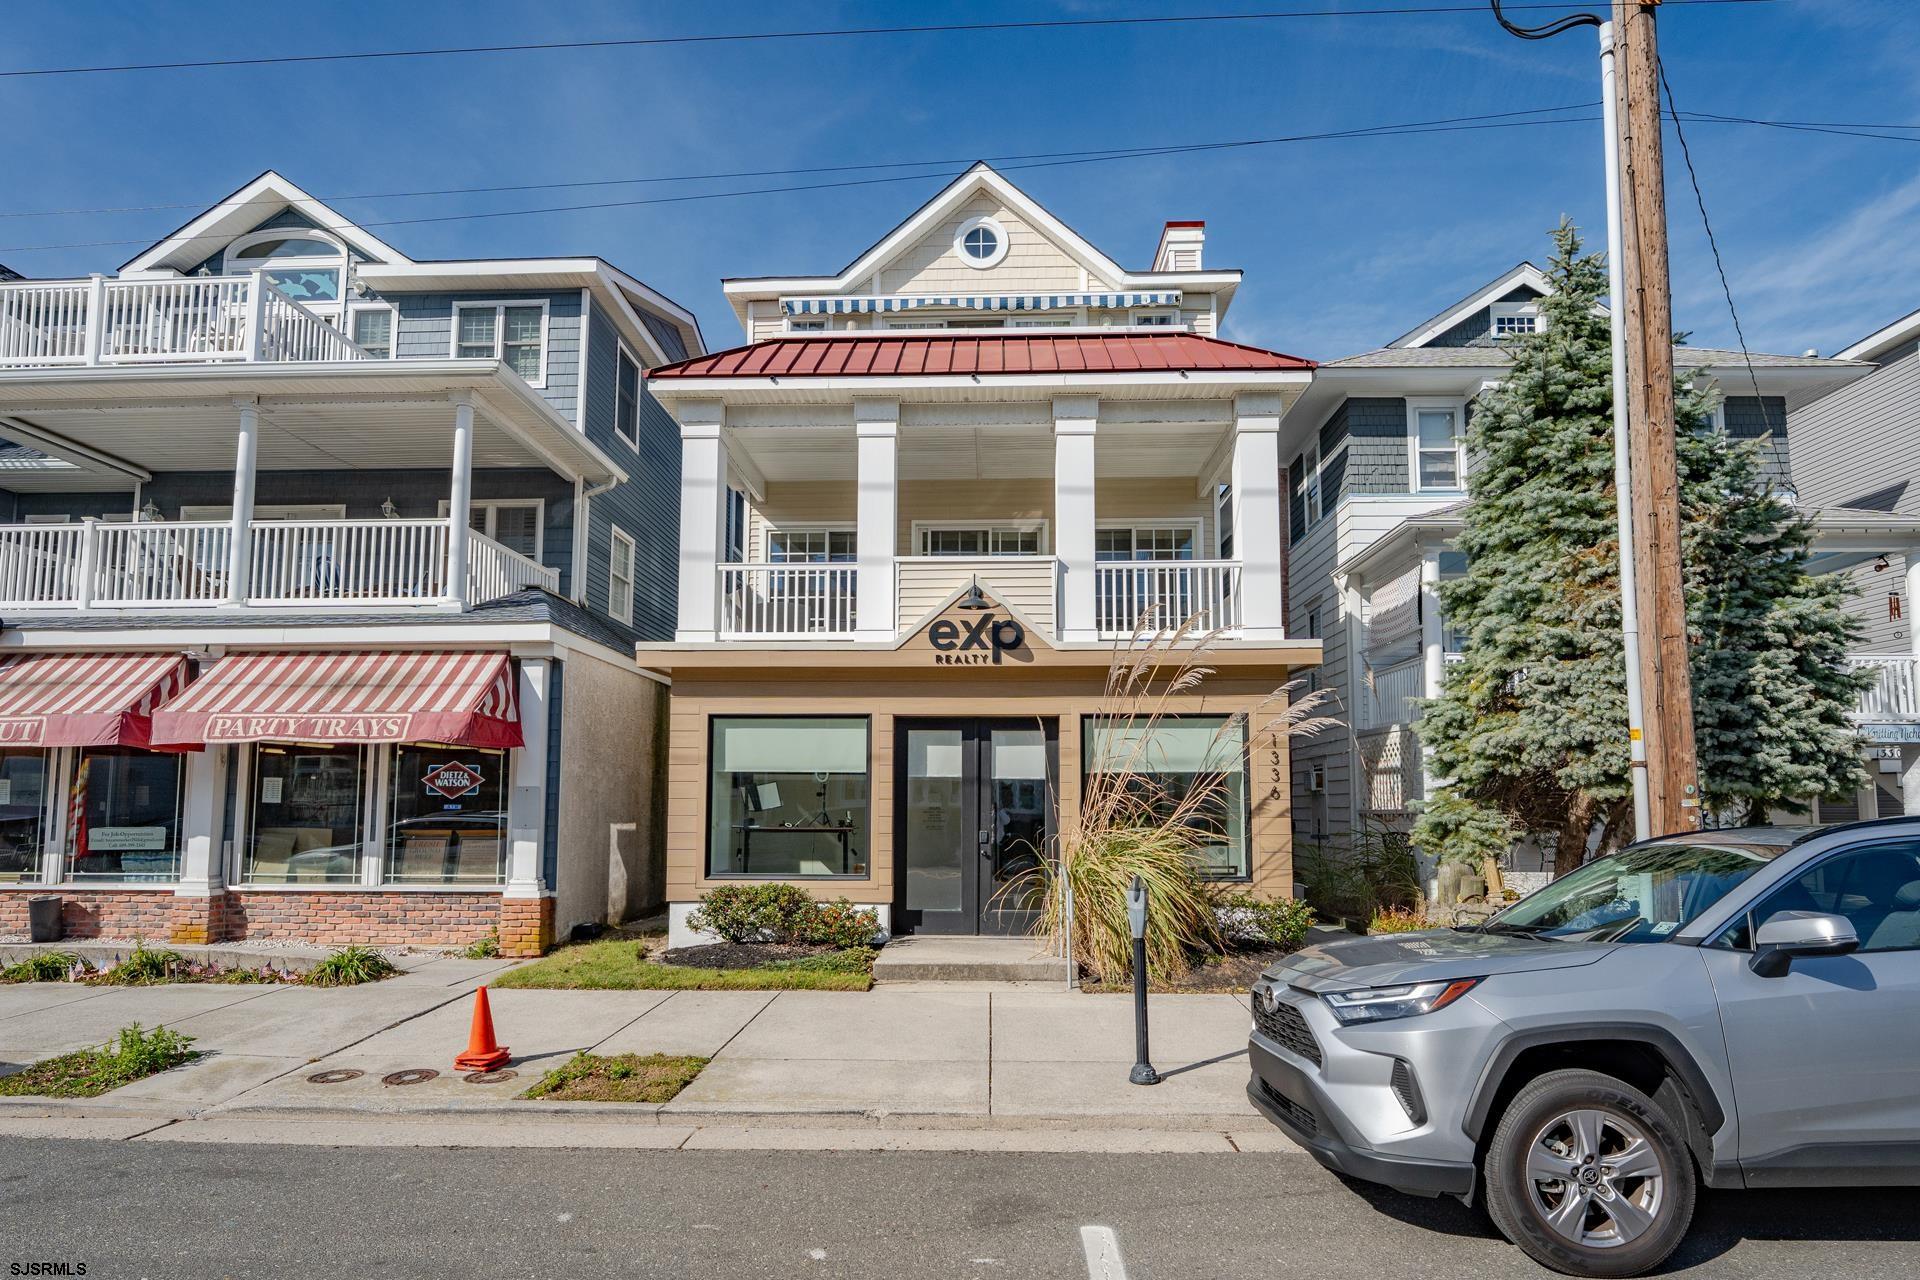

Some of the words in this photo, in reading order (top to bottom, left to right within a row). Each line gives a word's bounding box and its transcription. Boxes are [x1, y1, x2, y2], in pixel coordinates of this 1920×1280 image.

[935, 654, 989, 665] REALTY
[0, 722, 38, 741] UT
[212, 718, 304, 737] PARTY
[311, 718, 402, 737] TRAYS
[1270, 733, 1281, 800] 1336
[435, 779, 471, 787] WATSON
[1585, 1088, 1648, 1116] OPEN
